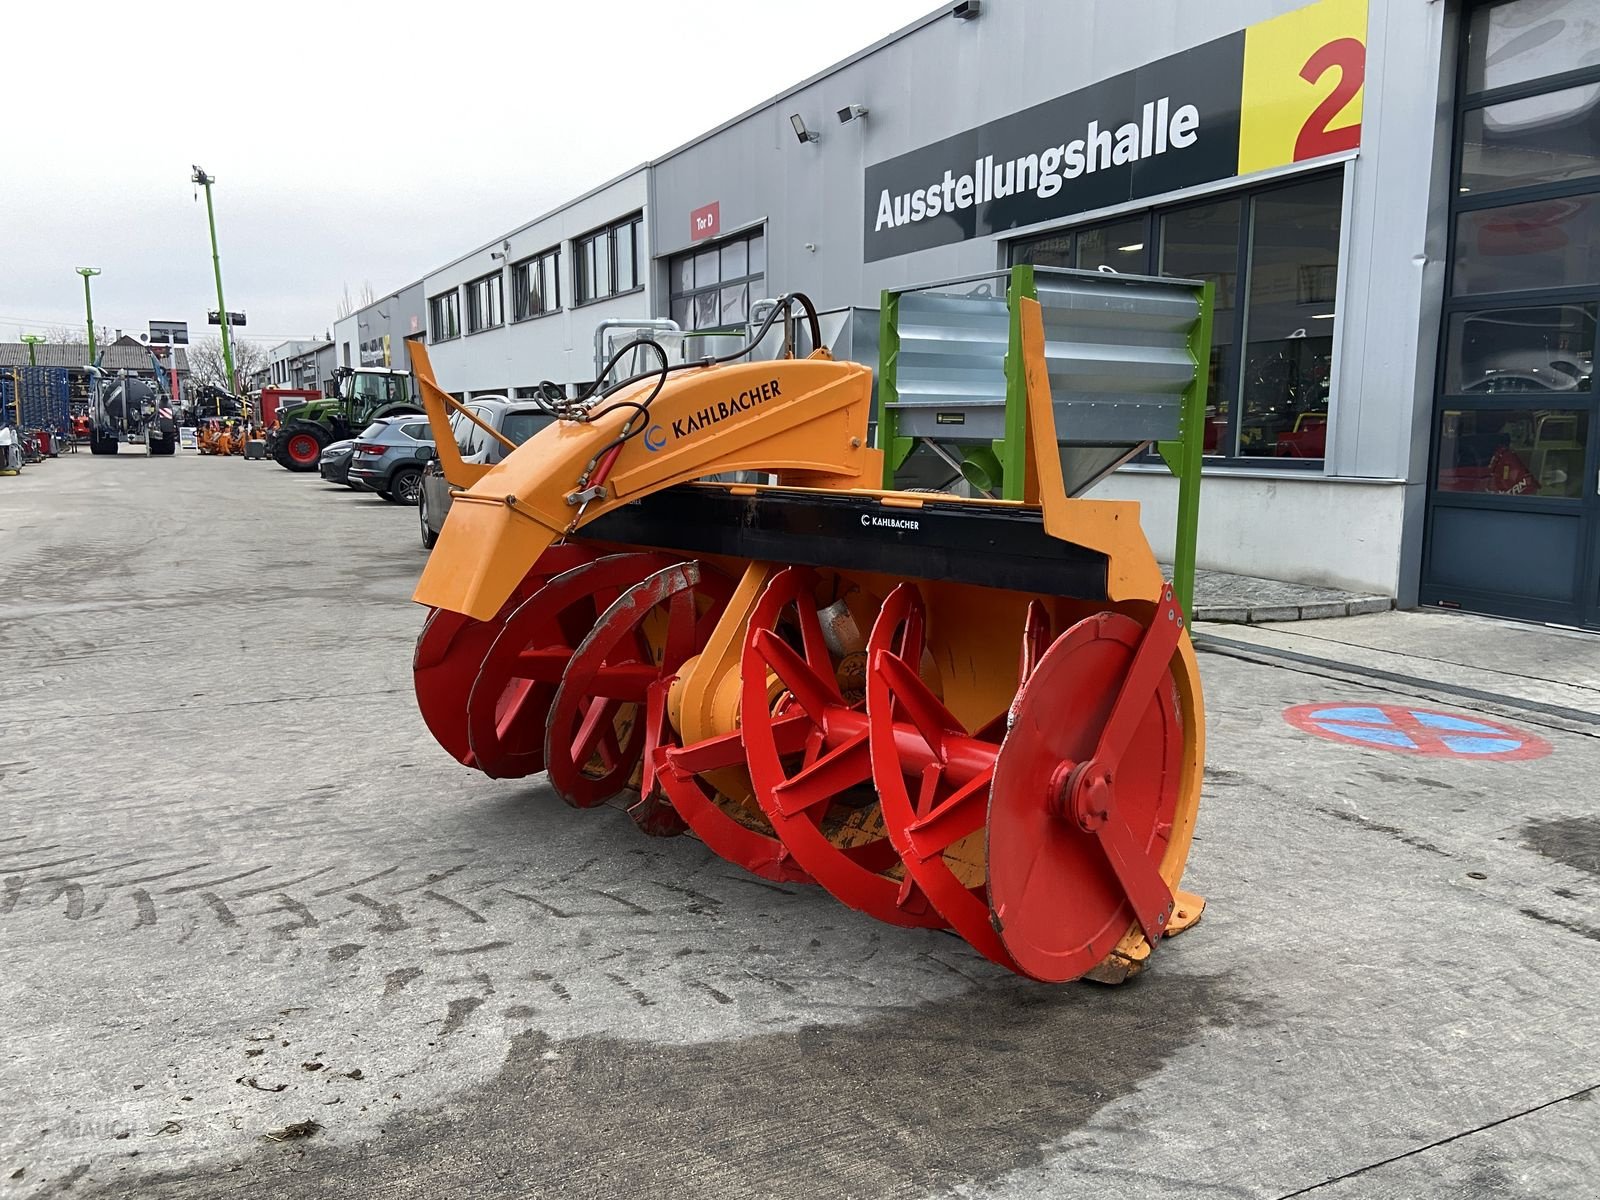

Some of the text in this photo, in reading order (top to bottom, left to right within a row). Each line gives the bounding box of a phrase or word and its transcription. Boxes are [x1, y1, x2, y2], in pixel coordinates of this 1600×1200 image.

[875, 37, 1366, 231] Ausstellungshalle 2
[697, 213, 713, 231] Tor D
[672, 380, 782, 439] KAHLBACHER
[872, 516, 919, 530] KAHLBACHER
